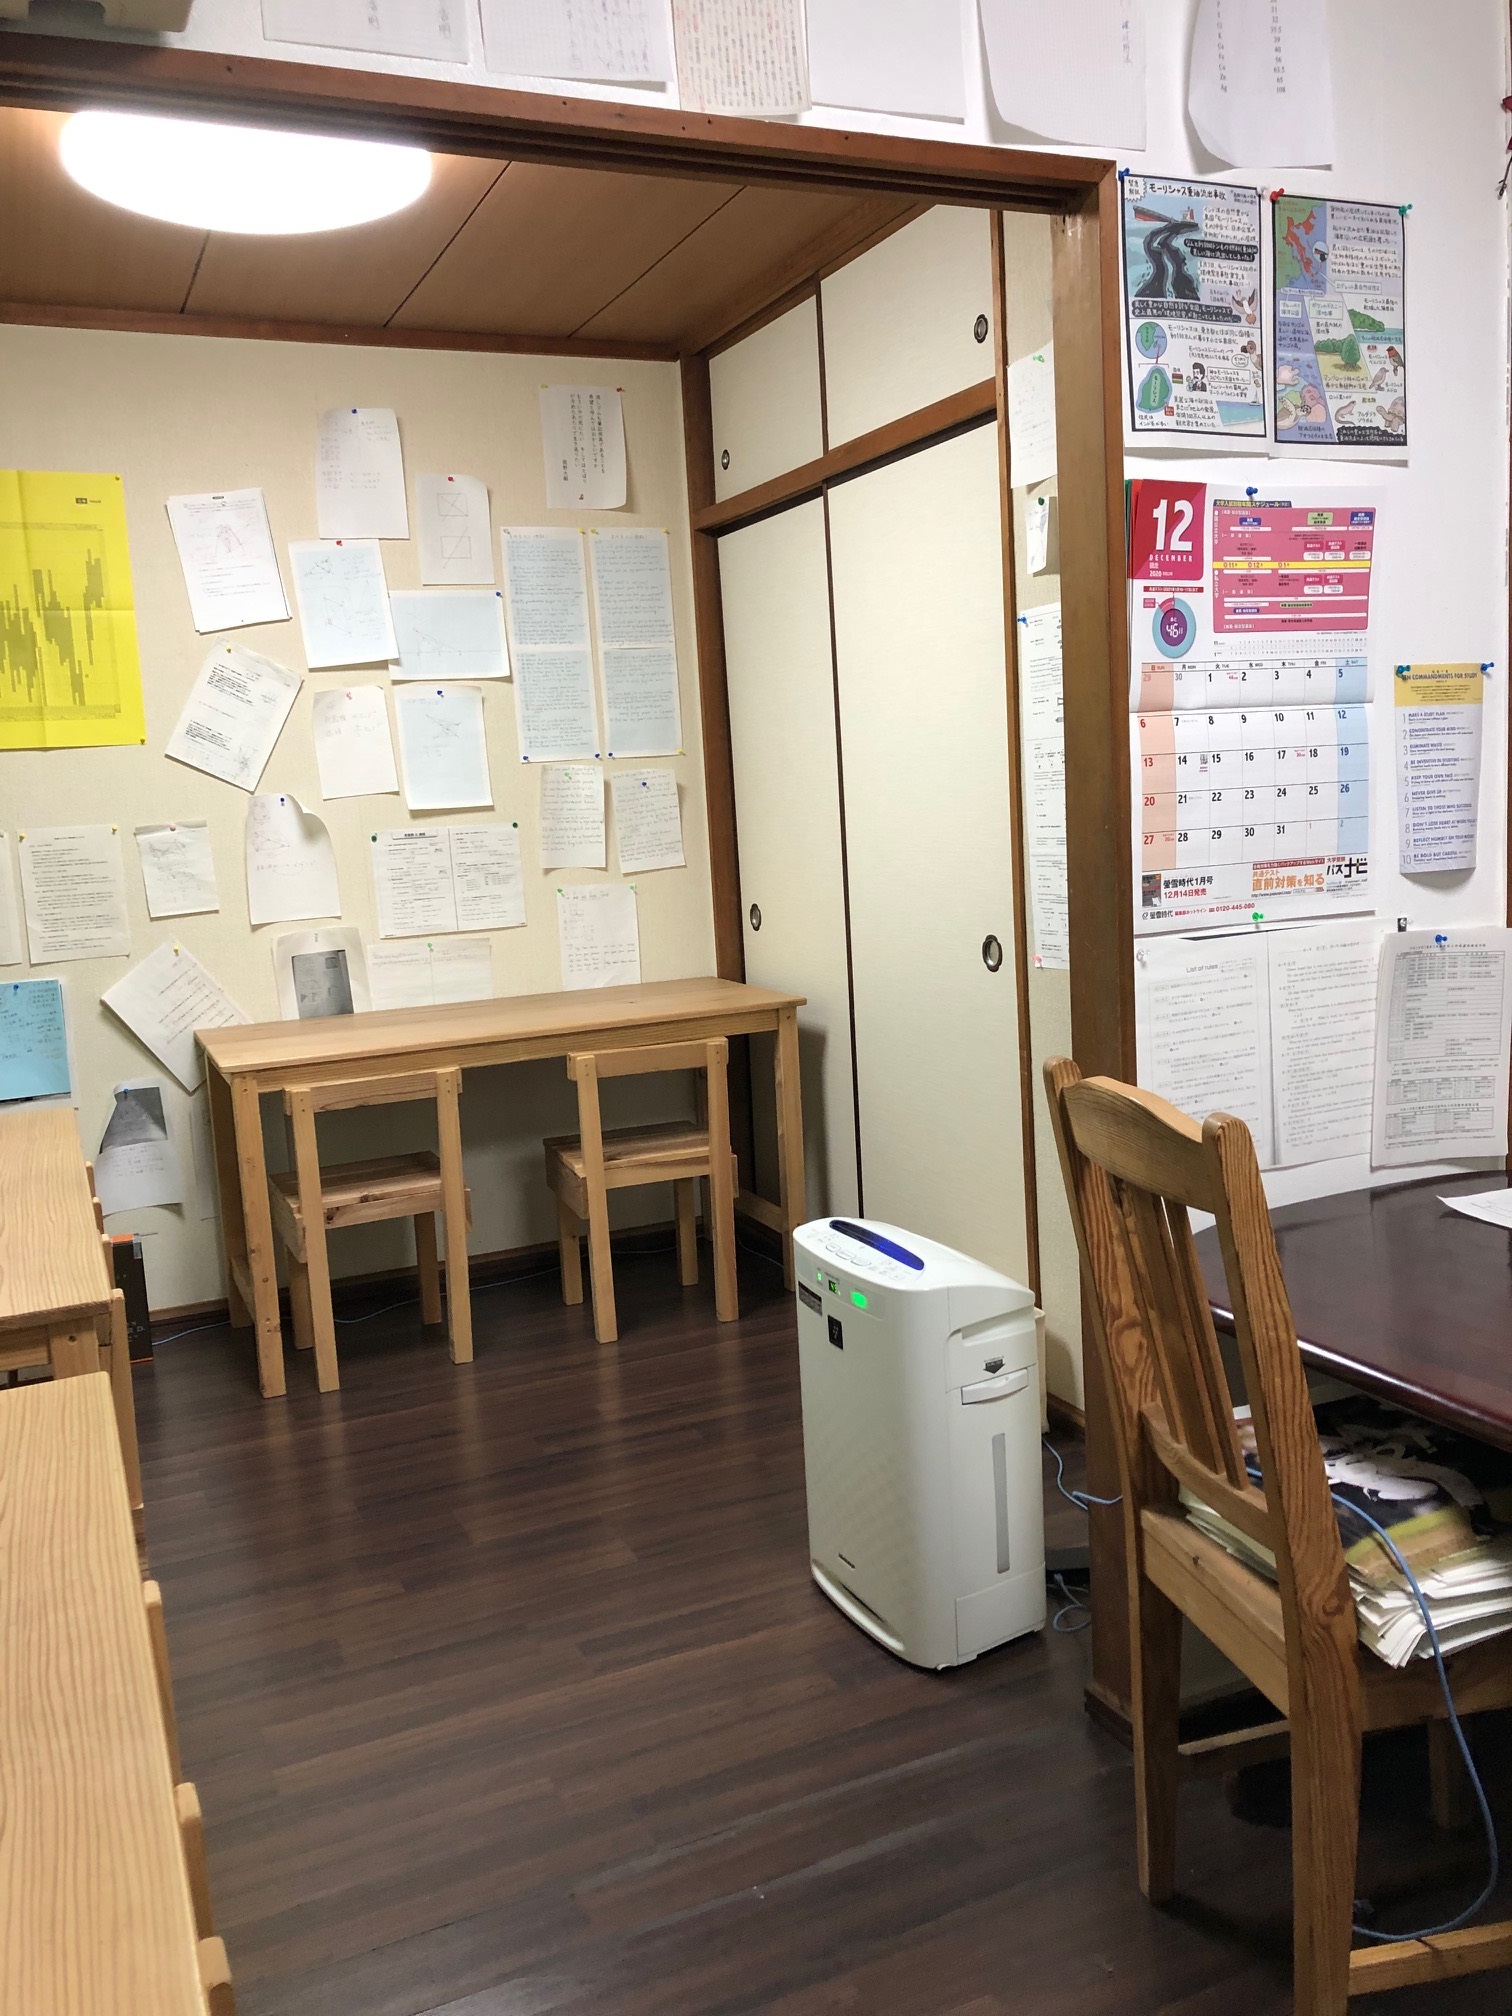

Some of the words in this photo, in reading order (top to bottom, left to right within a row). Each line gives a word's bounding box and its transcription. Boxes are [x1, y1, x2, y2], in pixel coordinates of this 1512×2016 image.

[1149, 184, 1226, 200] モーリシャス重油流出事故
[1153, 499, 1193, 551] 12
[1149, 554, 1193, 562] DECEMBER
[1175, 673, 1183, 681] 30
[1208, 673, 1212, 682] 1
[1241, 672, 1247, 681] 2
[1274, 671, 1280, 680] 3
[1306, 670, 1312, 679] 4
[1338, 669, 1343, 677] 5
[1140, 719, 1146, 728] 6
[1174, 717, 1179, 726] 7
[1208, 715, 1214, 725] 8
[1241, 714, 1247, 724] 9
[1275, 712, 1284, 722] 10
[1306, 711, 1315, 721] 11
[1337, 710, 1347, 719] 12
[1403, 730, 1407, 739] 2
[1404, 746, 1408, 755] 3
[1144, 758, 1154, 767] 13
[1177, 756, 1187, 765] 14
[1211, 754, 1221, 763] 15
[1244, 752, 1254, 761] 16
[1277, 750, 1286, 760] 17
[1309, 749, 1318, 758] 18
[1340, 747, 1349, 756] 19
[1404, 762, 1408, 770] 4
[1405, 777, 1409, 787] 5
[1144, 797, 1155, 806] 20
[1178, 795, 1187, 804] 21
[1211, 792, 1222, 802] 22
[1244, 790, 1255, 800] 23
[1277, 788, 1286, 797] 24
[1309, 786, 1318, 795] 25
[1340, 783, 1350, 793] 26
[1405, 793, 1409, 802] 6
[1405, 808, 1409, 817] 7
[1144, 835, 1154, 845] 27
[1178, 833, 1188, 842] 28
[1211, 830, 1221, 840] 29
[1244, 827, 1255, 837] 30
[1277, 825, 1285, 835] 31
[1340, 819, 1344, 827] 2
[1405, 824, 1410, 833] 8
[1406, 839, 1410, 848] 9
[1402, 855, 1411, 864] 10
[1327, 858, 1368, 878] パスナビ
[1253, 870, 1280, 878] 共通テスト
[1253, 873, 1324, 891] 直前対策を知る
[1164, 888, 1206, 899] 12月14日発売
[1216, 903, 1255, 912] 0120-445-080
